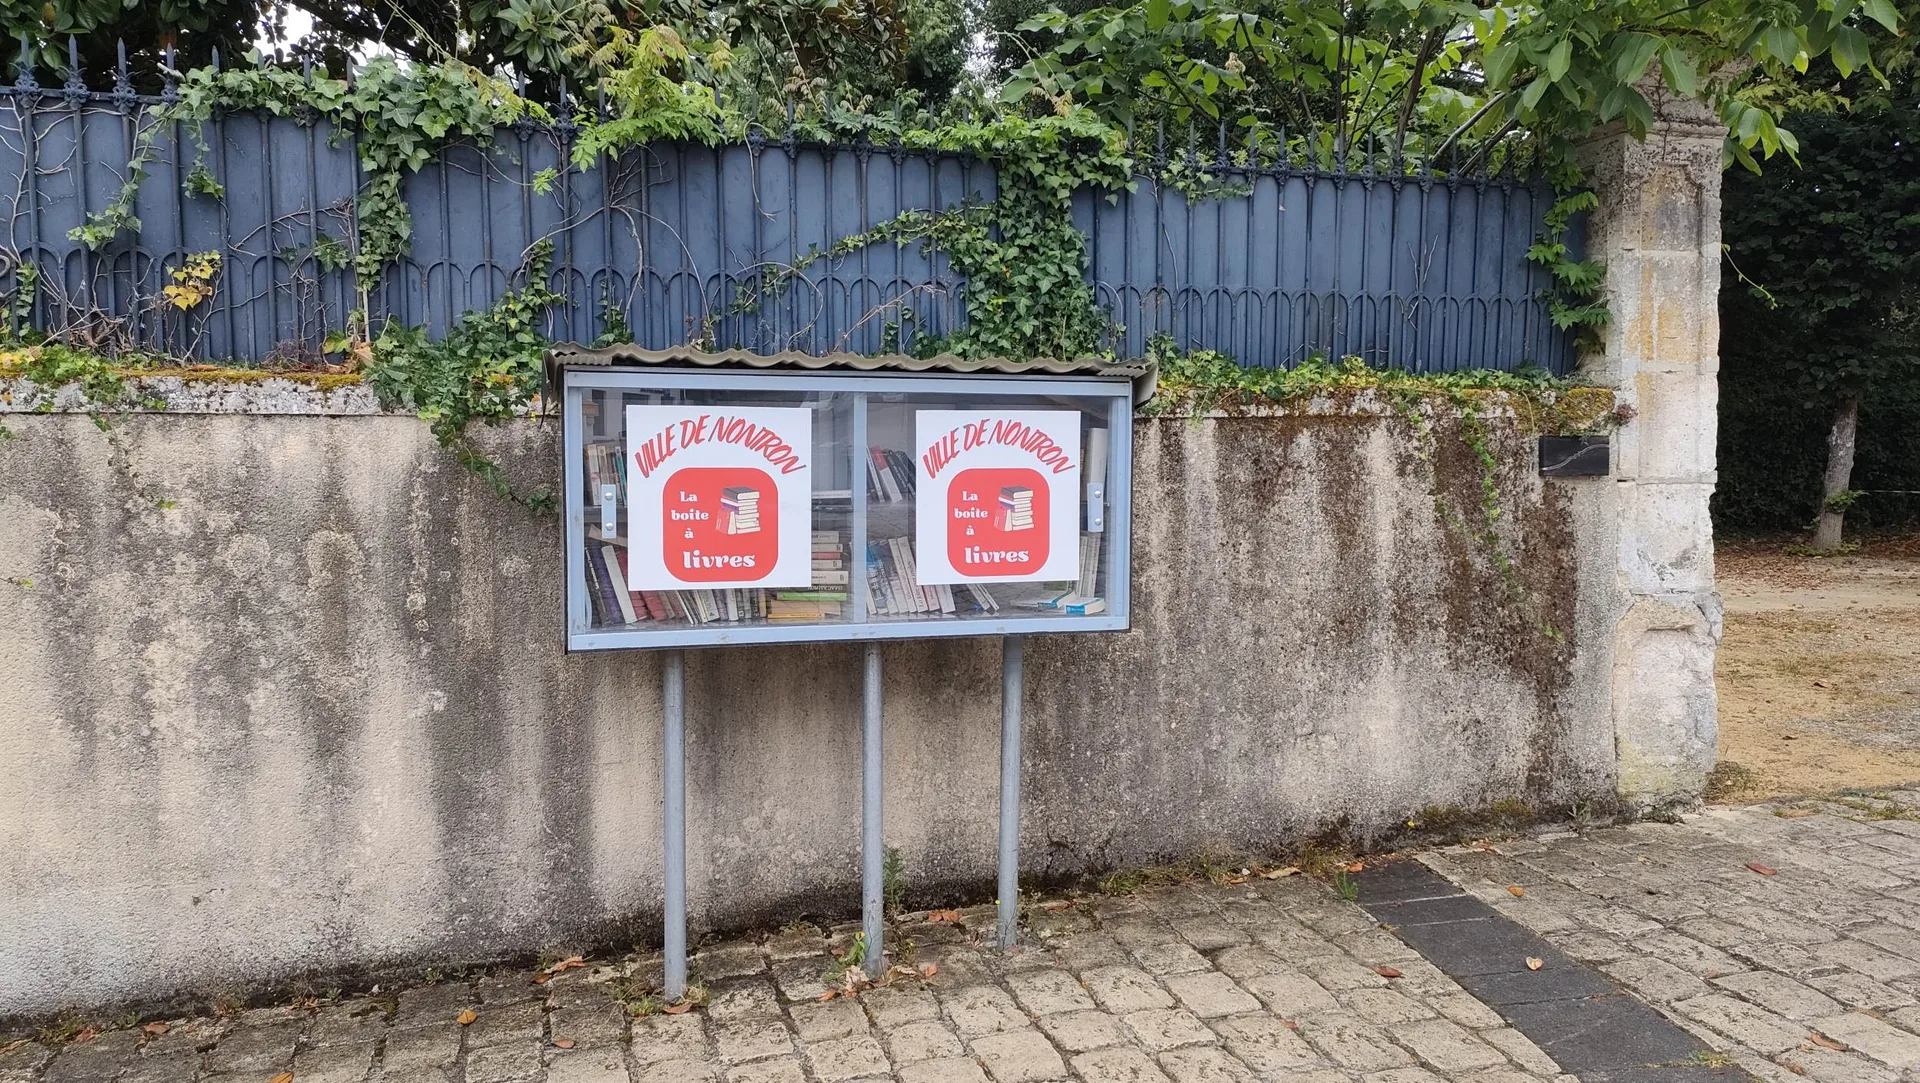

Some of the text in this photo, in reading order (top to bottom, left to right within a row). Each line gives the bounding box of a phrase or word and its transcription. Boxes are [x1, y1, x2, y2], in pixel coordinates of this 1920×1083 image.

[634, 414, 807, 478] VILLE DE NONTRON
[922, 418, 1075, 479] VILLE DE NONTRON
[680, 491, 698, 502] La
[962, 490, 979, 501] La
[671, 508, 710, 521] boite
[954, 506, 989, 519] boite
[684, 527, 694, 539] à
[966, 524, 975, 536] à
[683, 549, 756, 569] livres
[964, 545, 1030, 564] livres
